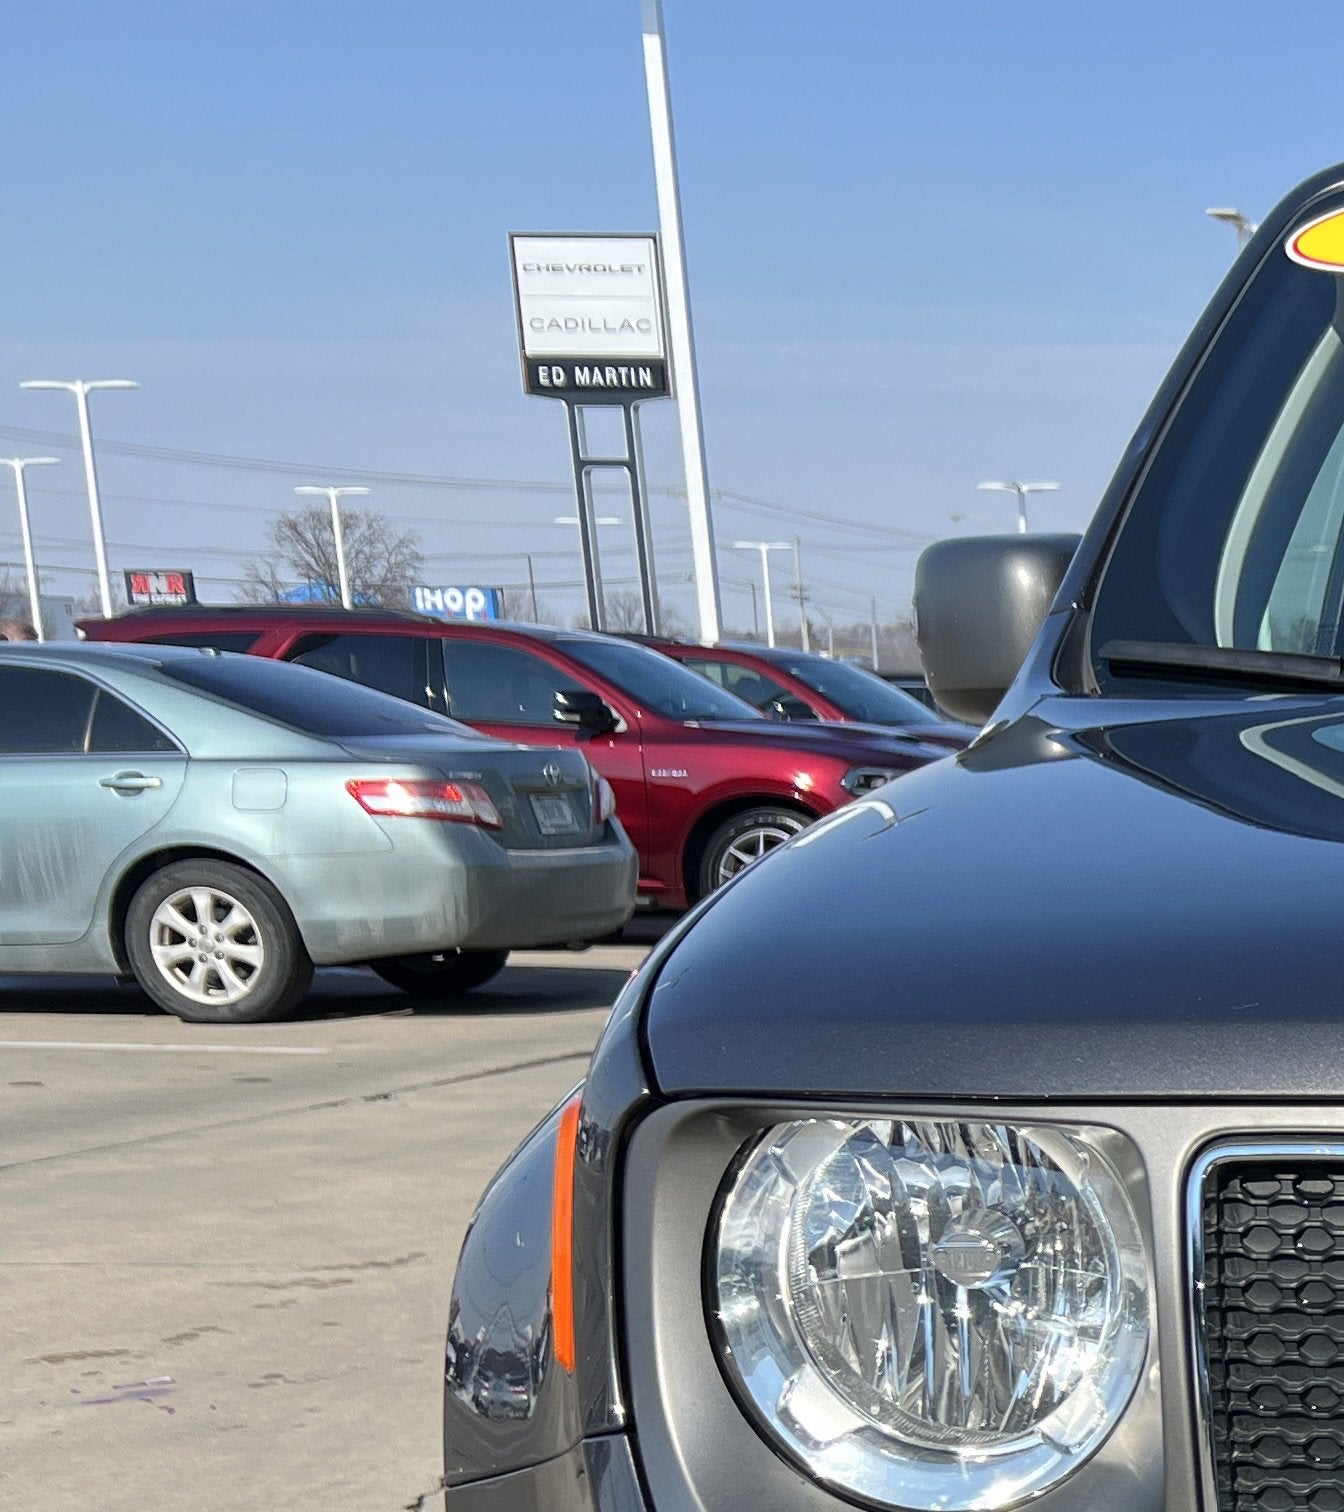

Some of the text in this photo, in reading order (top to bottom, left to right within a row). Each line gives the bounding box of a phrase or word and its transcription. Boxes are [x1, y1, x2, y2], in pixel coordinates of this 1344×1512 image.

[523, 263, 645, 275] CHEVROLET
[529, 317, 651, 333] CADILLAC
[538, 365, 653, 387] ED MARTIN
